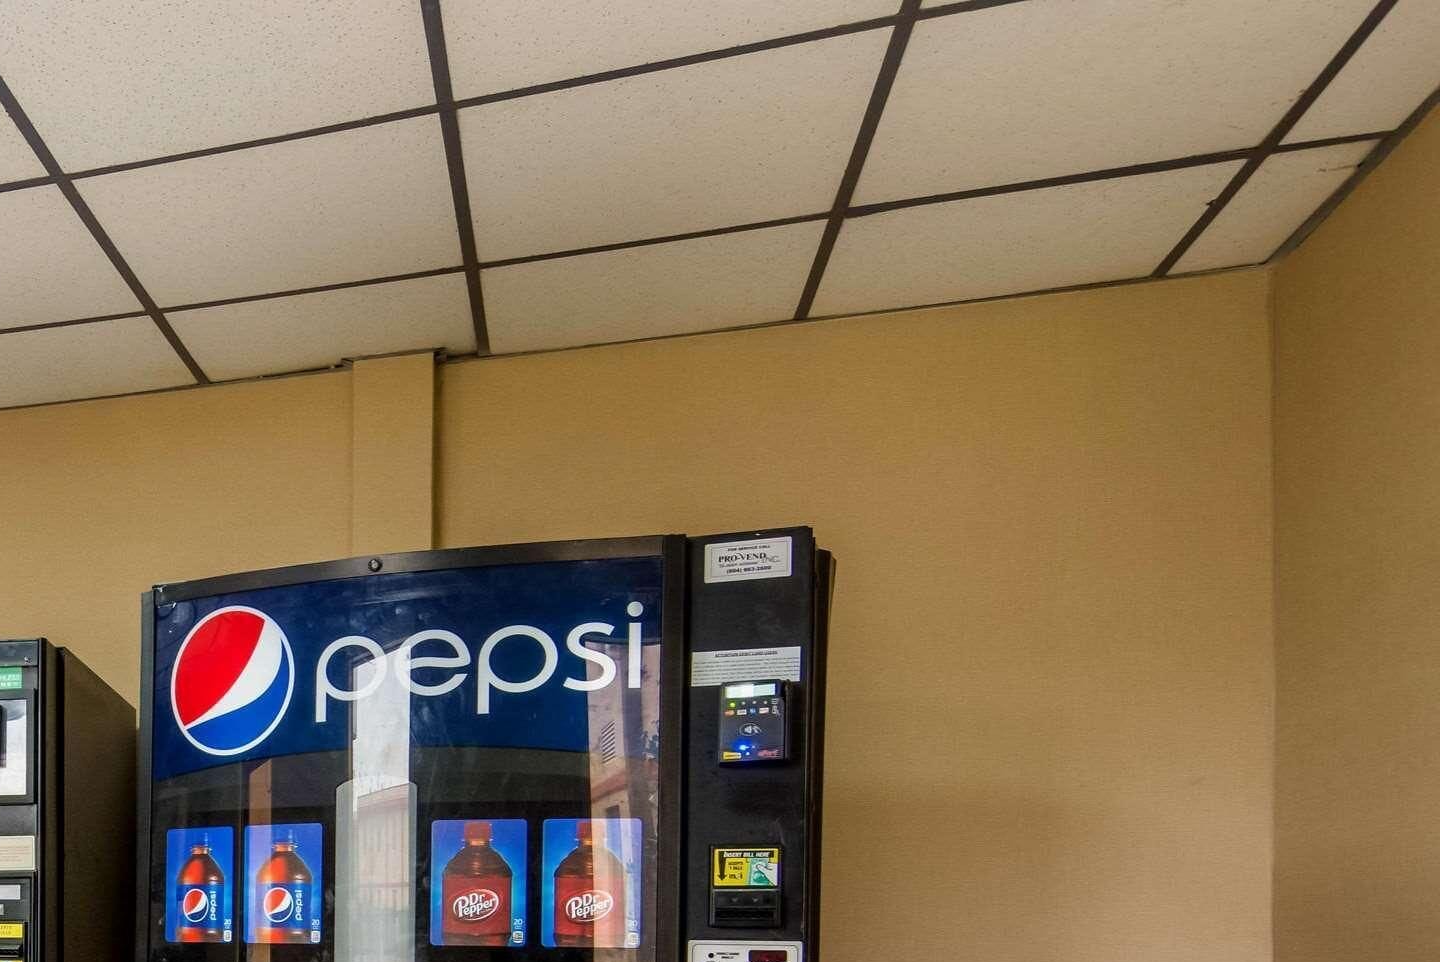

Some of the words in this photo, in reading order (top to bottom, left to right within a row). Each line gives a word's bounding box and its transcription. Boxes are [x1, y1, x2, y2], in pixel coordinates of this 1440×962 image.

[718, 552, 767, 563] PRO-VEND
[315, 601, 644, 723] pepsi
[209, 889, 218, 921] pepsi
[295, 889, 304, 921] pepsi
[458, 896, 497, 918] Pepper
[469, 892, 486, 905] Dr
[570, 898, 610, 919] Pepper
[582, 893, 598, 905] Dr
